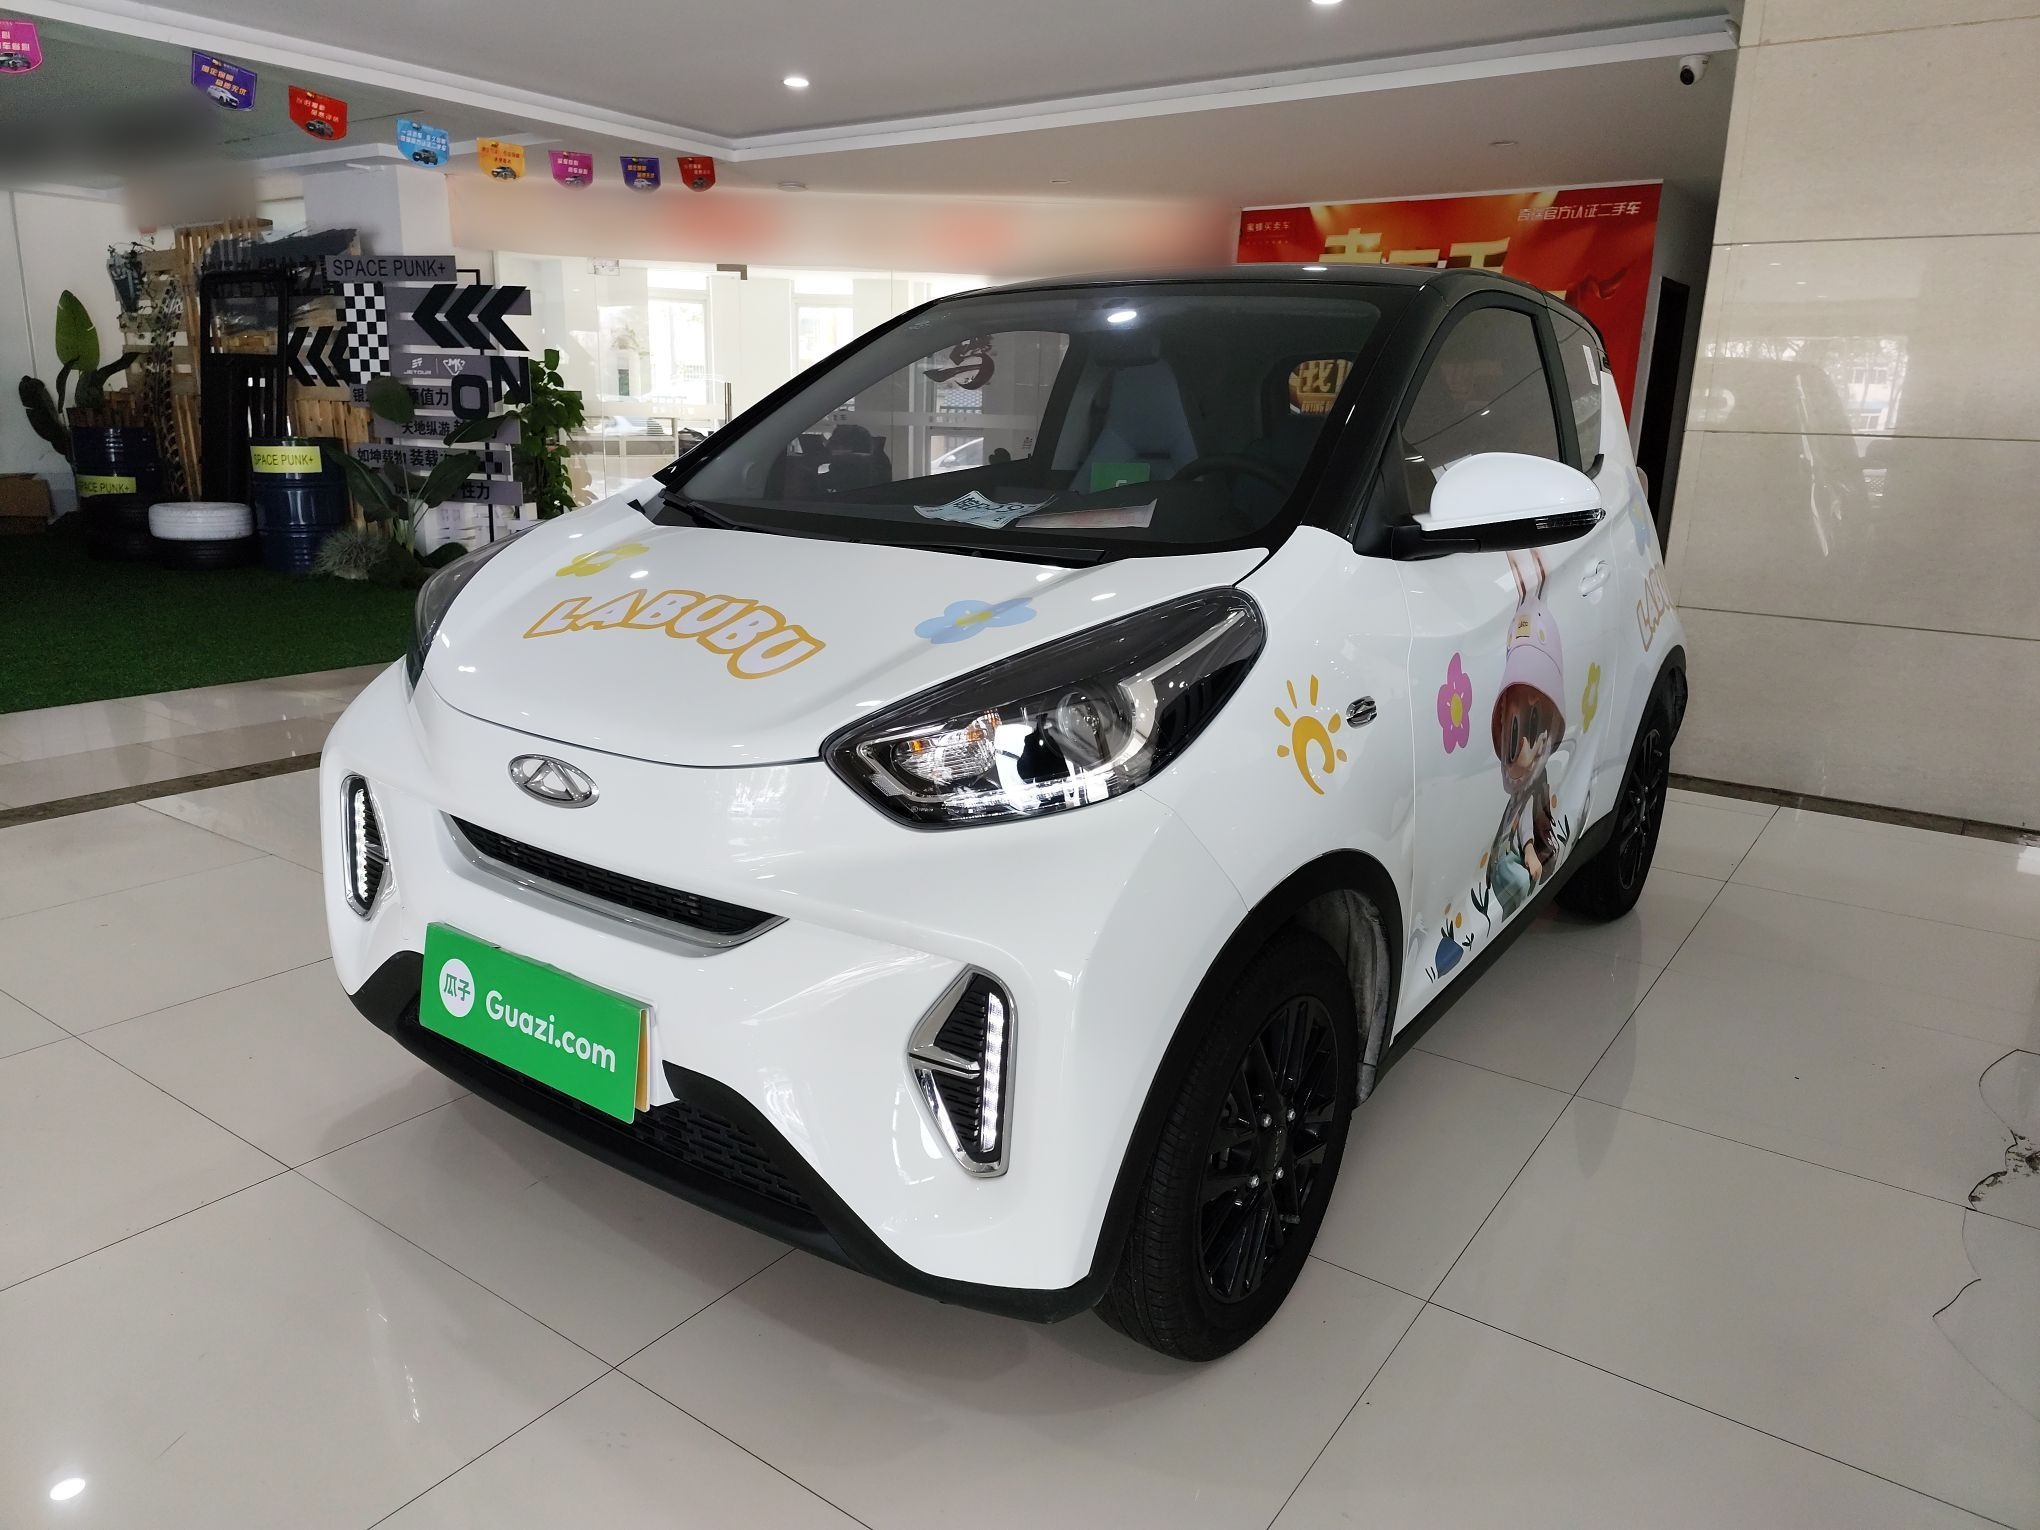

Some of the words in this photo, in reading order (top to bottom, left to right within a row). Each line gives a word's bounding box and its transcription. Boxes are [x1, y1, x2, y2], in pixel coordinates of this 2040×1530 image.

[333, 259, 388, 277] SPACE
[393, 260, 446, 277] PUNK+
[253, 453, 279, 466] SPACE
[282, 453, 314, 466] PUNK+
[409, 448, 446, 467] 装载
[522, 588, 826, 679] LABUBU
[443, 973, 471, 1002] 瓜子
[485, 990, 616, 1073] Guazi.com
